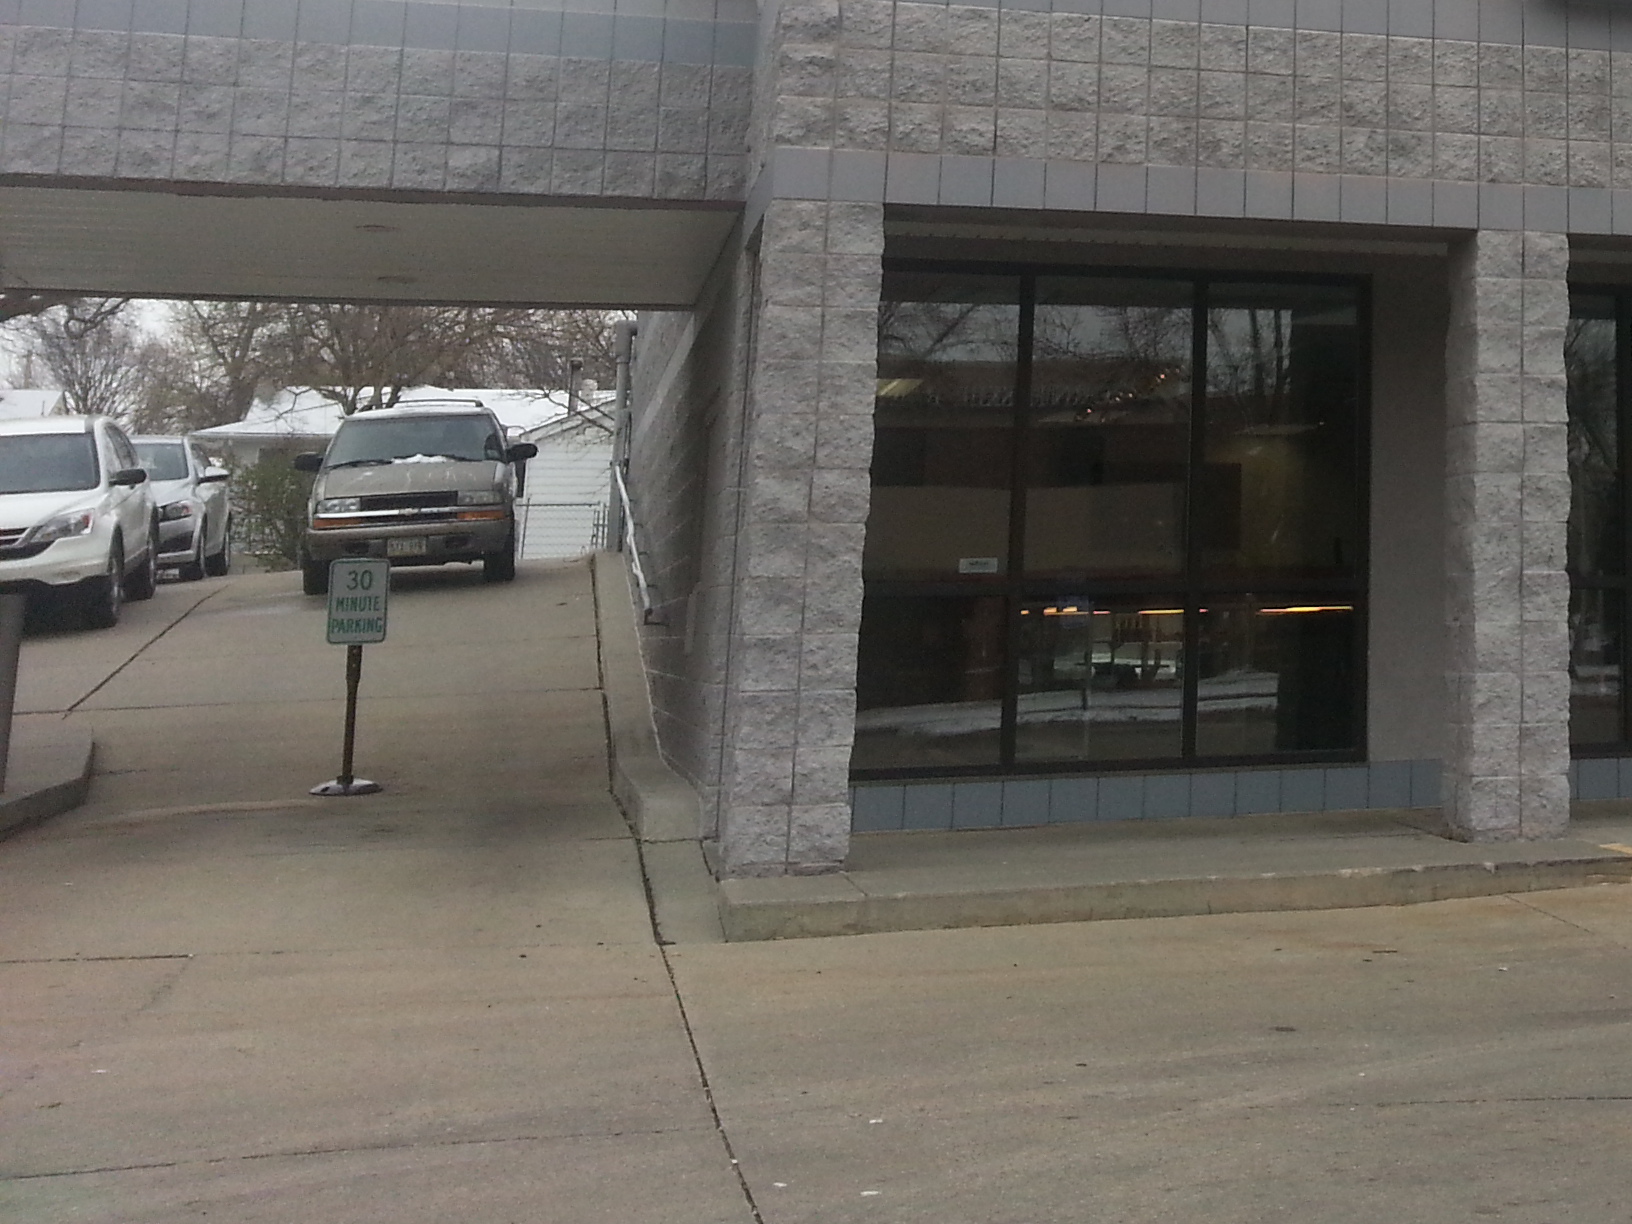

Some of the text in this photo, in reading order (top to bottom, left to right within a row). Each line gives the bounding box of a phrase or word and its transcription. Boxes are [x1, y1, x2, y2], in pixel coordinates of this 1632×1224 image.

[346, 569, 374, 591] 30
[335, 595, 381, 613] MINUTE
[331, 616, 383, 634] PARKING
